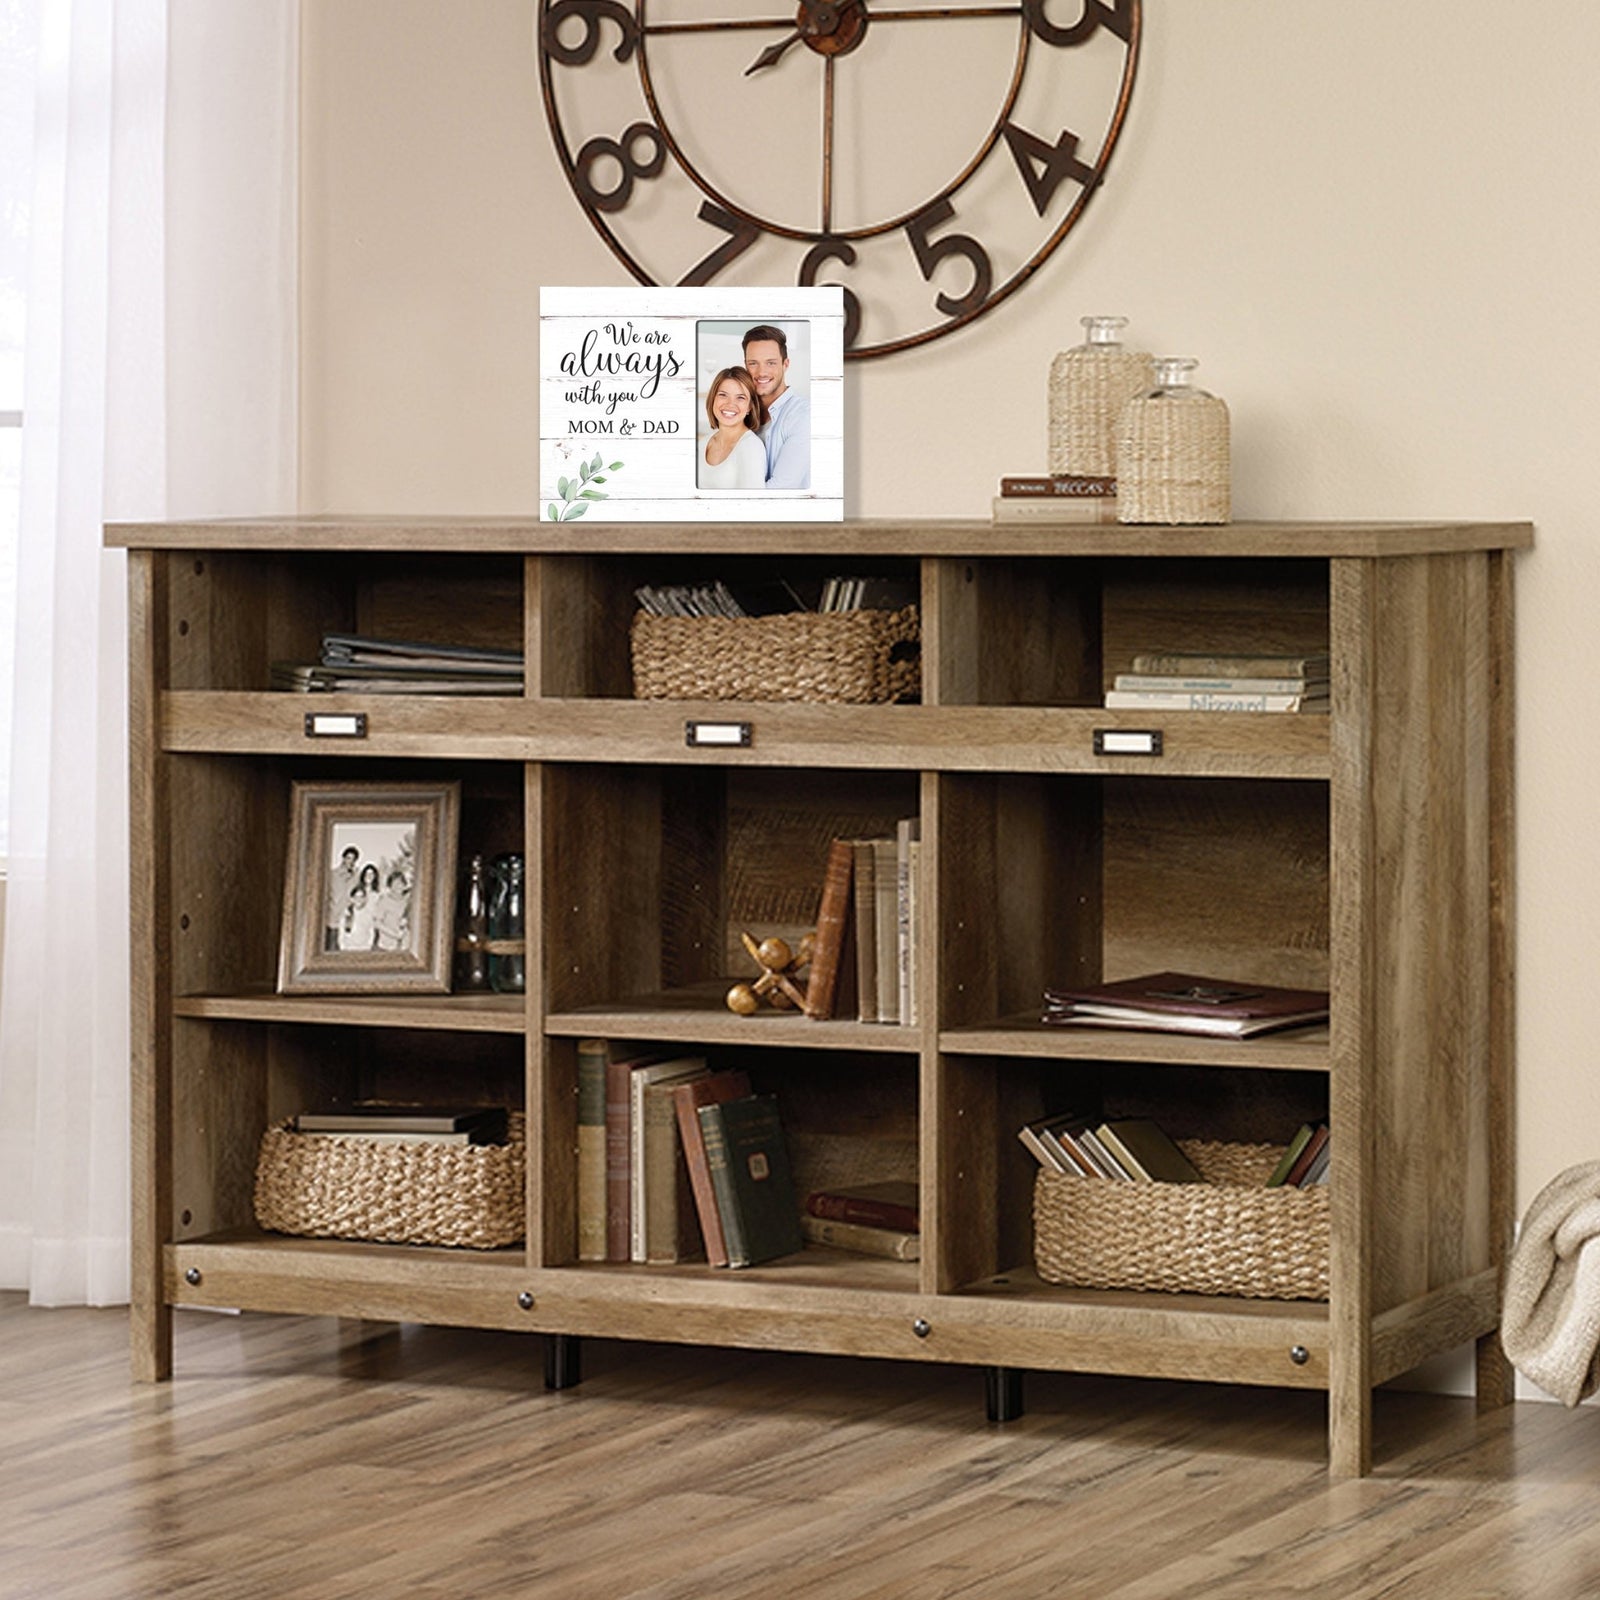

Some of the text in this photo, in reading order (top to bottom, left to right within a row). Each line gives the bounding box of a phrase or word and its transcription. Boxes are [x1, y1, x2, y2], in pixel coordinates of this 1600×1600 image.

[541, 0, 638, 67] 9
[575, 122, 666, 214] 8
[1002, 120, 1102, 217] 4
[676, 199, 760, 287] 7
[903, 198, 993, 318] 5
[560, 329, 685, 400] always
[603, 321, 671, 347] We are
[564, 379, 639, 416] with you
[567, 418, 680, 436] MOM & DAD
